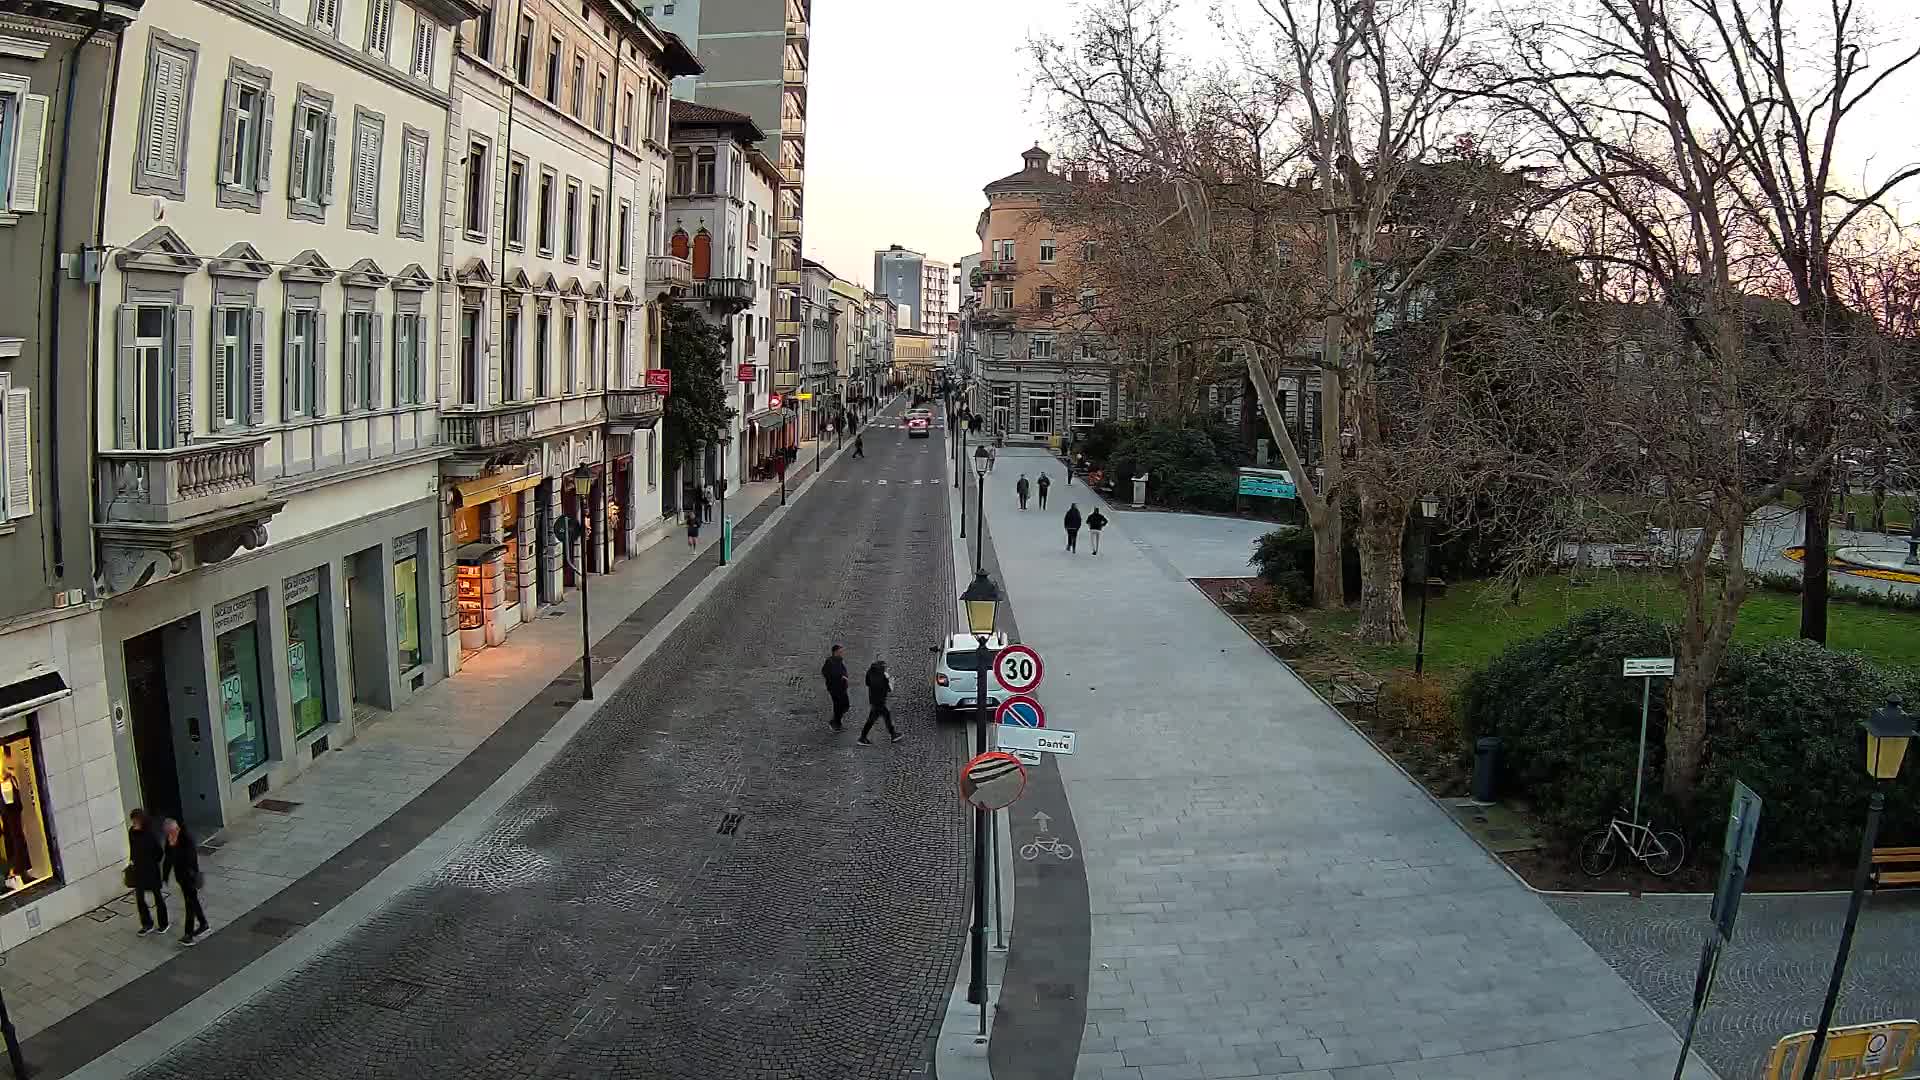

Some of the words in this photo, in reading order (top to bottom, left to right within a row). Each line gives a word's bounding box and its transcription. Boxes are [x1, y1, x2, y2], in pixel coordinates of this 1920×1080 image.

[1005, 658, 1033, 680] 30
[224, 678, 240, 701] 130
[1038, 738, 1069, 749] Dante
